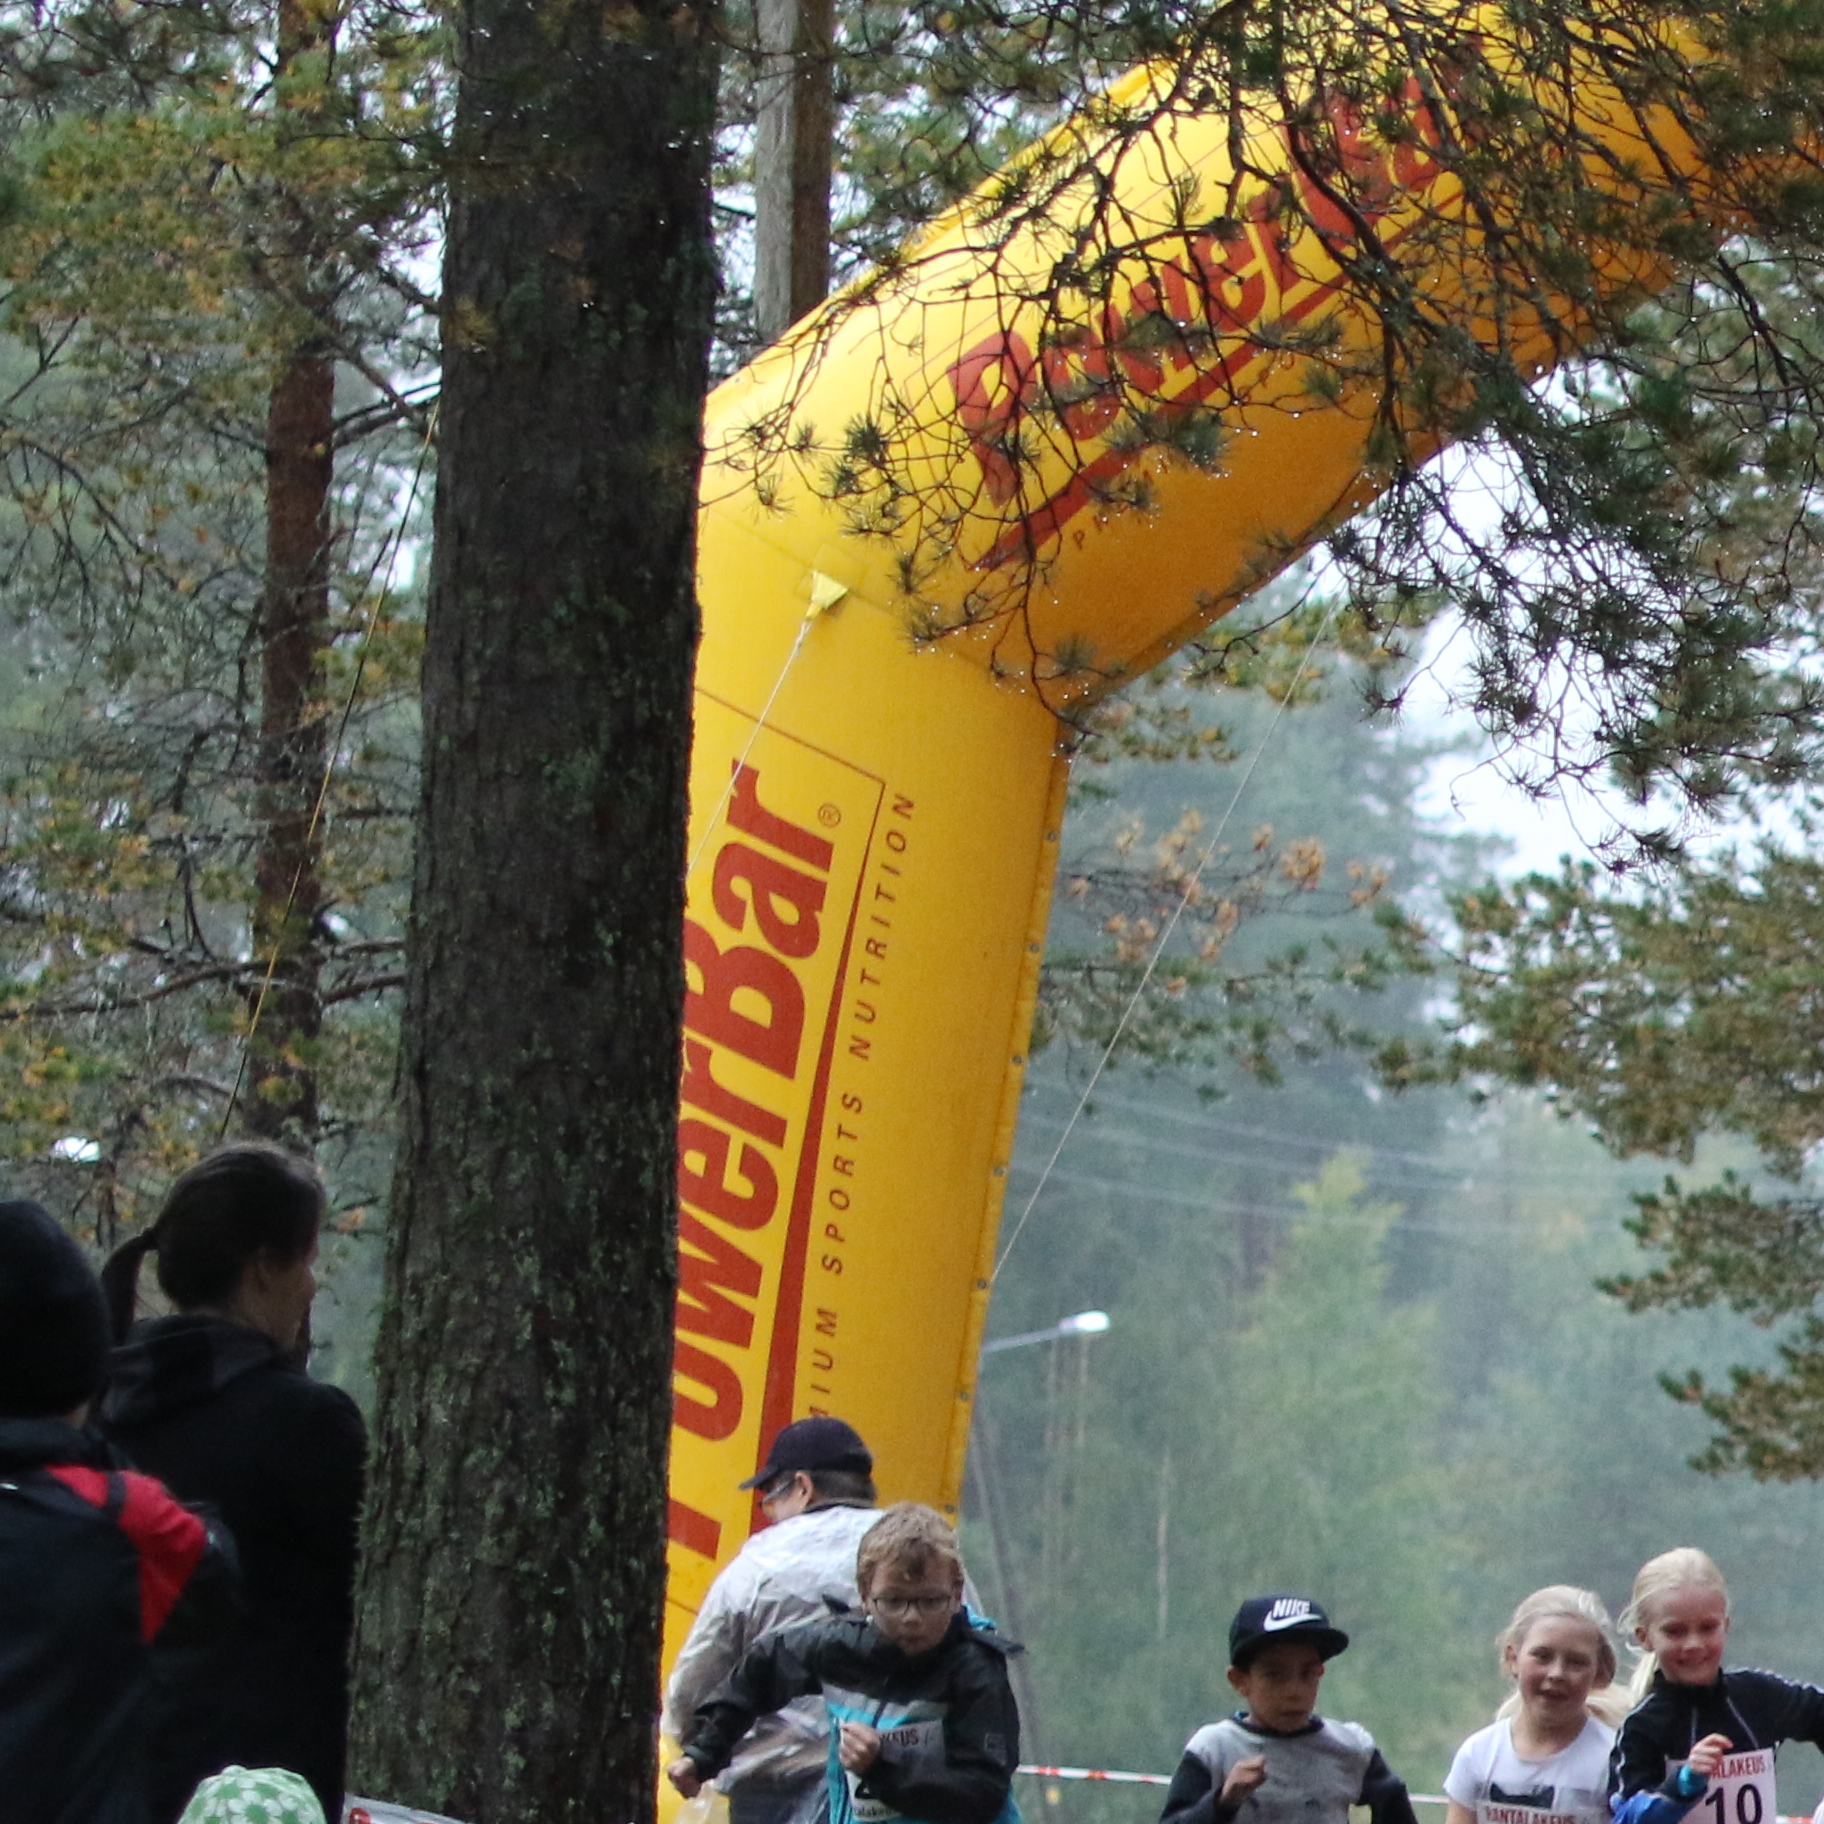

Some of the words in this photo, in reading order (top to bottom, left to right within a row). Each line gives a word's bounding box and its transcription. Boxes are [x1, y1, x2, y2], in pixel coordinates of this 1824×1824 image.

[821, 1091, 864, 1276] SPORTS
[848, 792, 916, 1061] NUTRITION
[1272, 1598, 1311, 1619] NIKE
